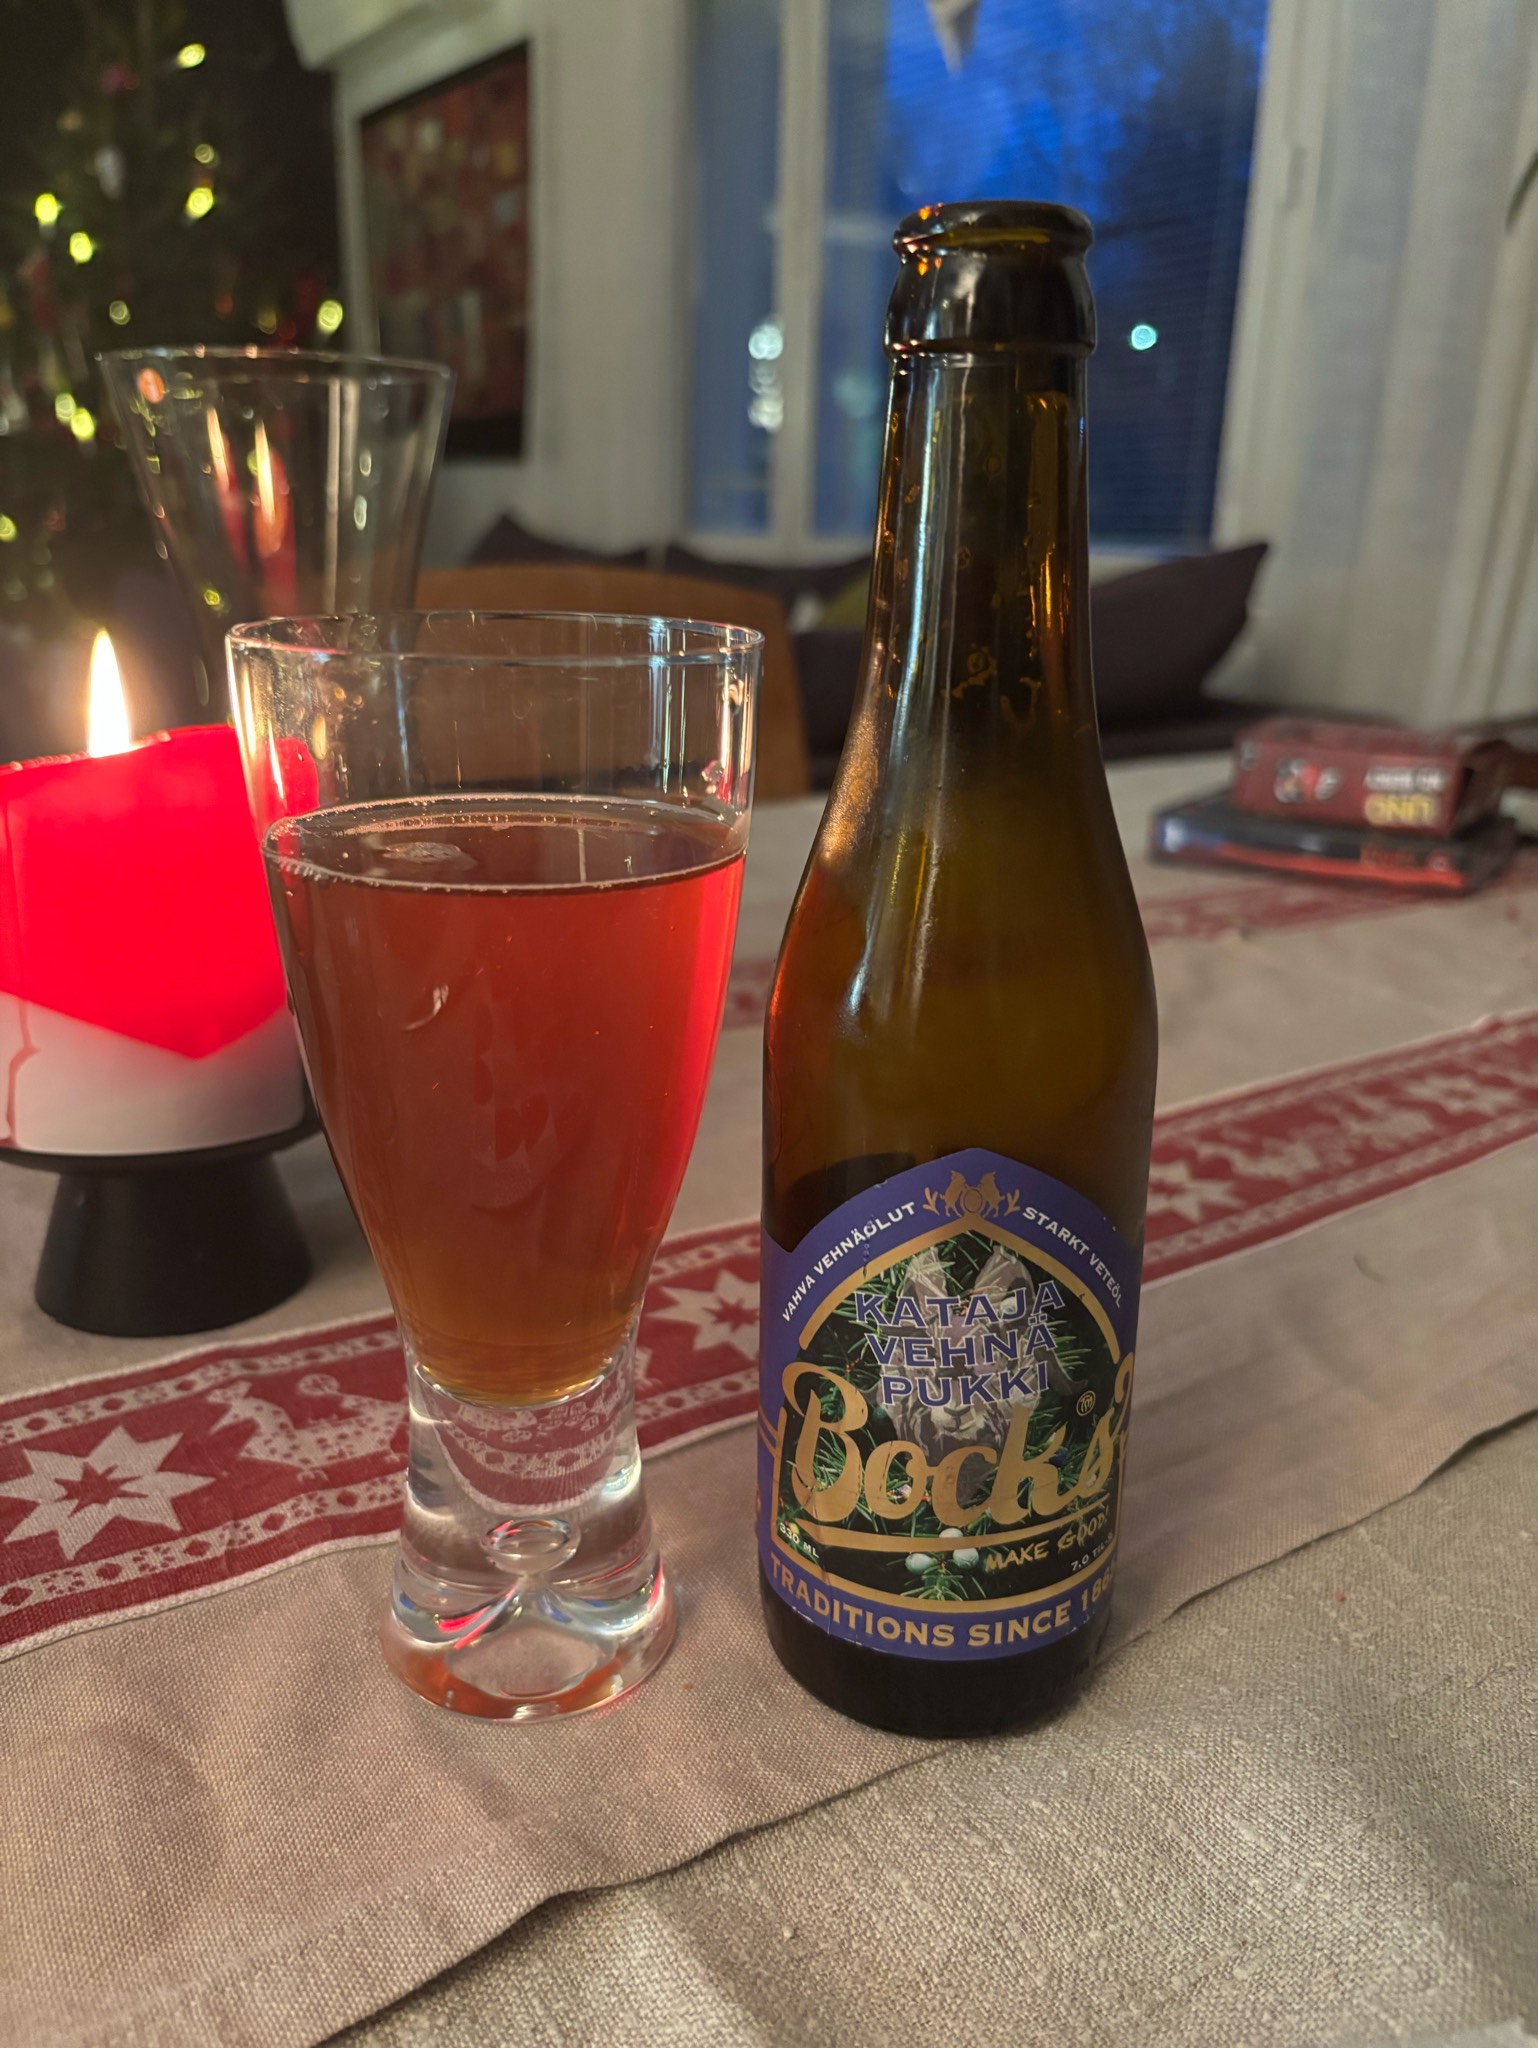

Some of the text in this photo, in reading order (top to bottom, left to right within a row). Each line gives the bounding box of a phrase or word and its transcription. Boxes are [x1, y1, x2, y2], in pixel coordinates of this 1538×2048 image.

[1022, 1206, 1122, 1309] STARKT VETEÖL
[782, 1274, 816, 1322] VAHVA
[854, 1280, 1065, 1329] KATAJA
[864, 1313, 1058, 1368] VEHNÄ
[881, 1360, 1050, 1407] PUKKI
[780, 1522, 820, 1559] 330 ML
[984, 1507, 1109, 1574] MAKE GOOD!
[770, 1552, 955, 1647] TRADITIONS
[968, 1599, 1072, 1647] SINCE
